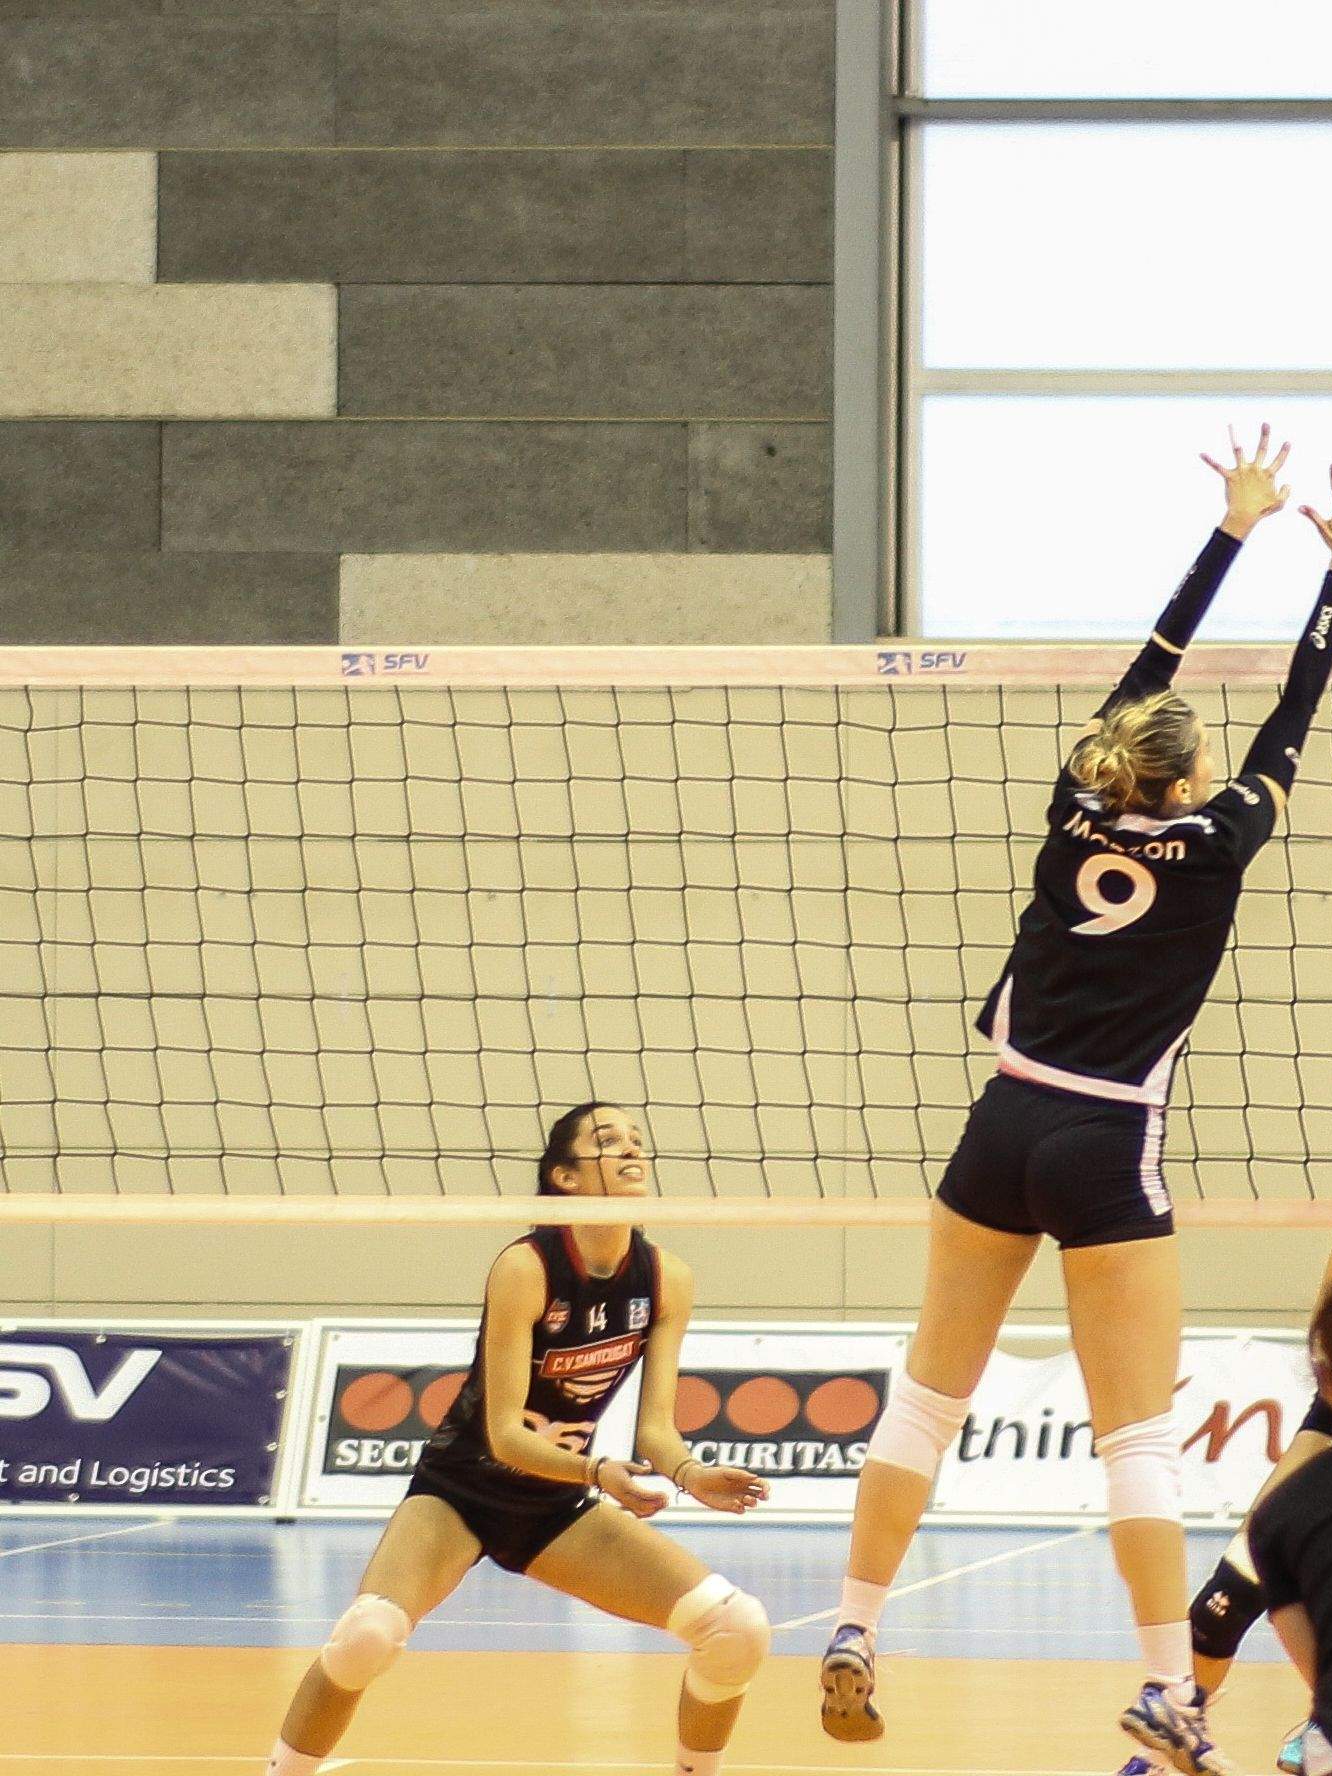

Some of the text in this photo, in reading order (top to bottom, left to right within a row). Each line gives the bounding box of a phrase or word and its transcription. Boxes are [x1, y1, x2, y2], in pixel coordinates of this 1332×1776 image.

[1069, 853, 1158, 935] 9
[588, 1302, 608, 1334] 14
[958, 1407, 1098, 1463] thin
[688, 1441, 868, 1470] CURITAS
[18, 1458, 82, 1484] and
[90, 1461, 236, 1493] Logistics
